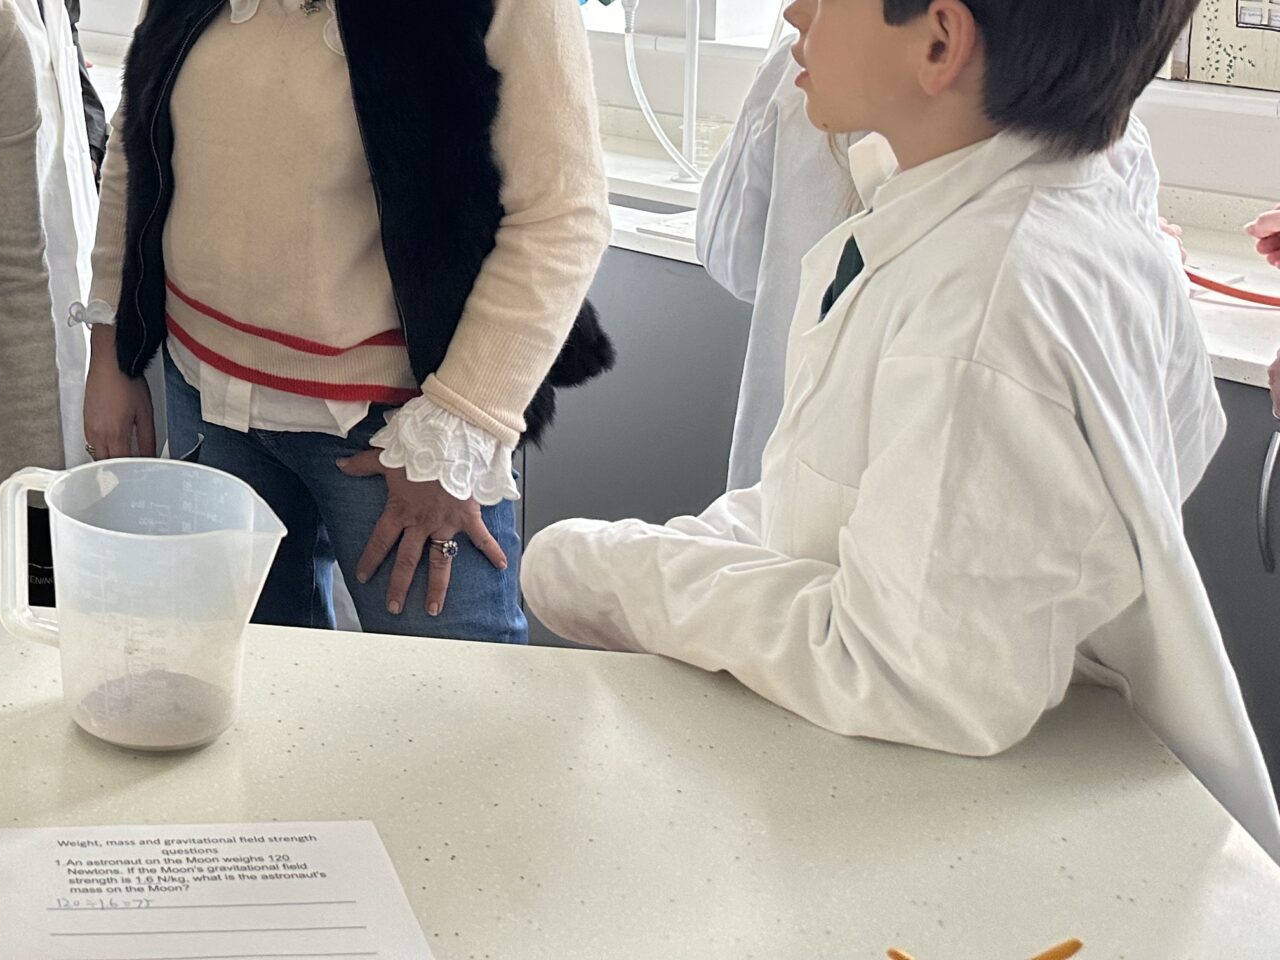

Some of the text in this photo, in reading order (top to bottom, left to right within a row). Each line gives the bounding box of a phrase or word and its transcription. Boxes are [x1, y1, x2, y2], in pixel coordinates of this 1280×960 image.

[139, 838, 160, 846] and
[164, 836, 236, 847] gravitational
[240, 835, 265, 844] field
[268, 834, 318, 844] strength
[161, 847, 218, 856] questions
[66, 859, 83, 867] An
[86, 857, 142, 866] astronaut
[163, 857, 183, 865] the
[186, 856, 220, 864] Moon
[222, 855, 265, 864] weighs
[268, 854, 290, 862] 120
[138, 866, 157, 874] the
[160, 865, 204, 874] Moon's
[207, 863, 280, 874] gravitational
[282, 862, 308, 870] field
[69, 876, 118, 885] strength
[136, 875, 154, 884] 1.6
[193, 873, 222, 882] what
[239, 872, 258, 880] the
[261, 871, 327, 880] astronaut's
[70, 886, 103, 894] mass
[125, 885, 145, 893] the
[148, 884, 190, 893] Moon?
[57, 897, 81, 908] 120
